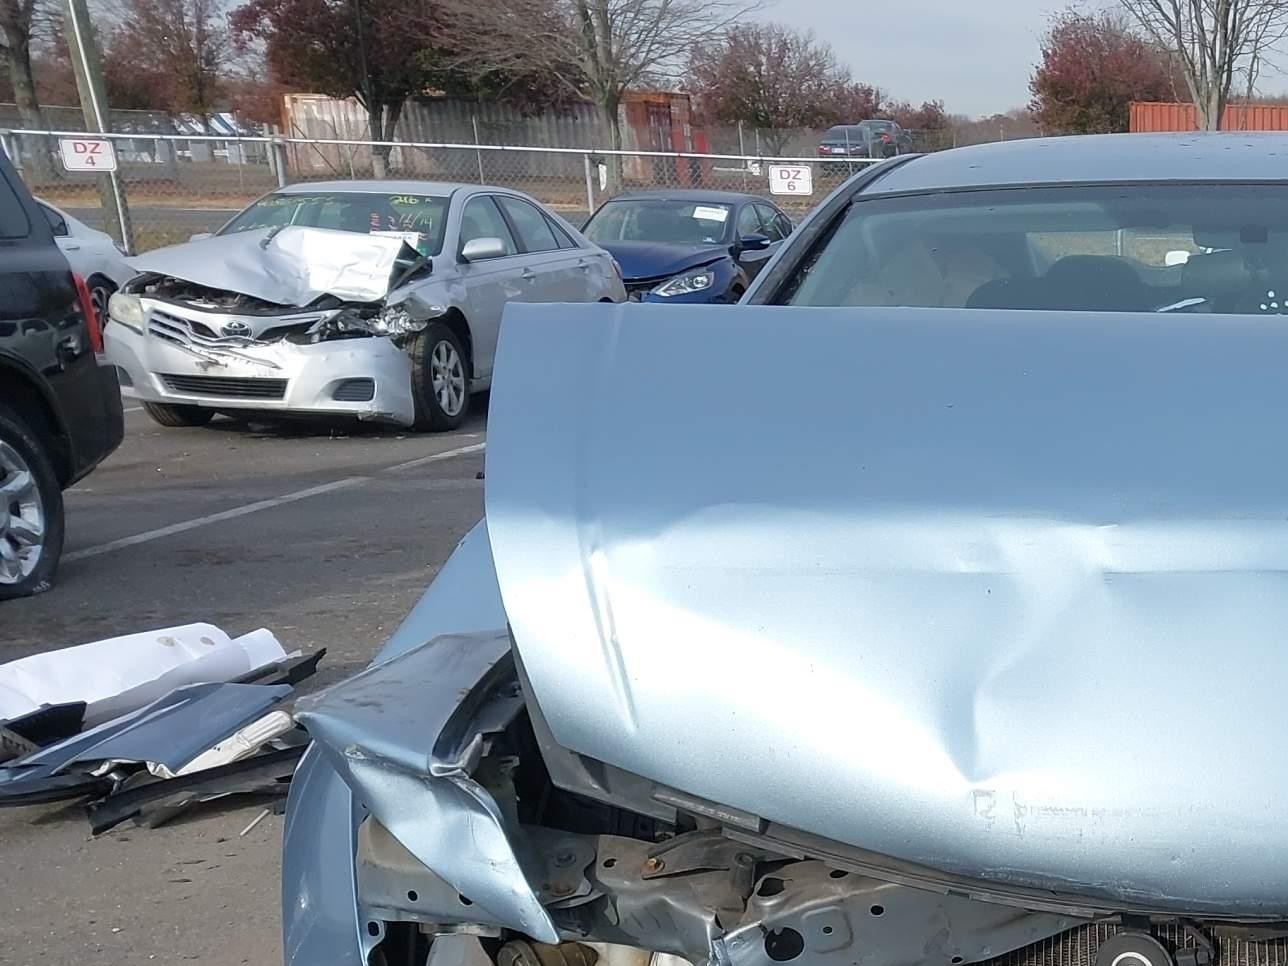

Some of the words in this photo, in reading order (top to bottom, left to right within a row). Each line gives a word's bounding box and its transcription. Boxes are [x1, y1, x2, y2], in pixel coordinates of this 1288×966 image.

[73, 142, 102, 154] DZ
[85, 155, 96, 166] 4
[780, 169, 802, 180] DZ
[787, 181, 796, 191] 6
